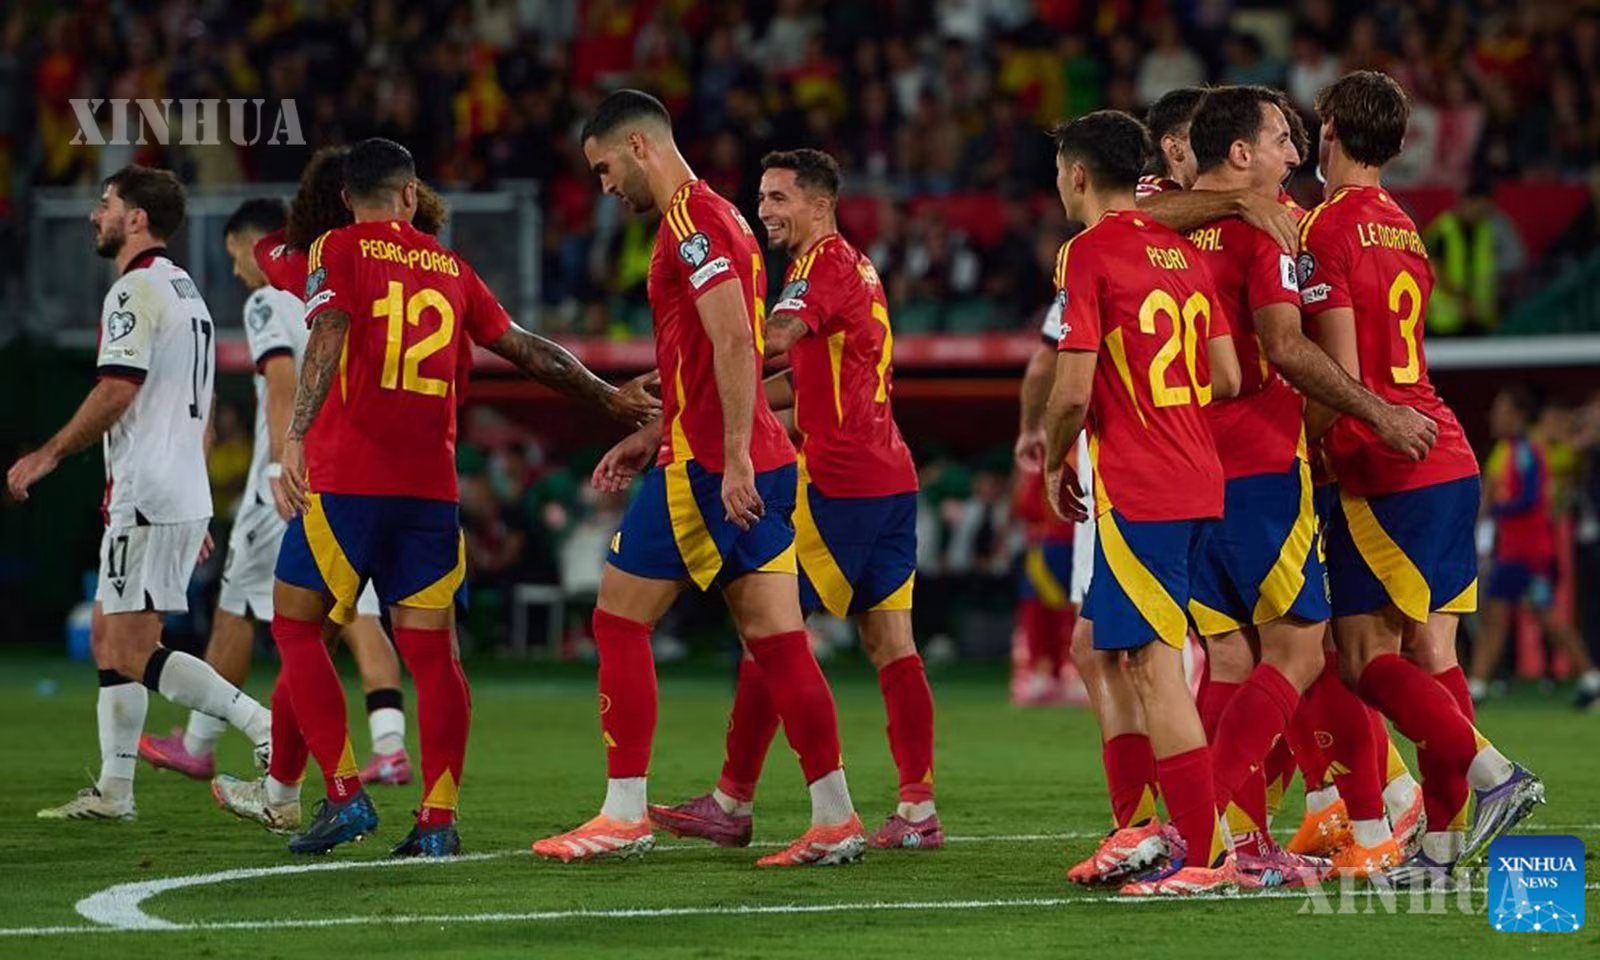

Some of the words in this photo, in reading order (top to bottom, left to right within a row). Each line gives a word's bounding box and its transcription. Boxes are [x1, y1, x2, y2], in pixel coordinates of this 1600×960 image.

[1146, 245, 1188, 269] PEDRI
[189, 317, 212, 419] 17
[372, 280, 455, 398] 12
[1138, 288, 1212, 407] 20
[1388, 270, 1422, 384] 3
[107, 534, 130, 579] 17
